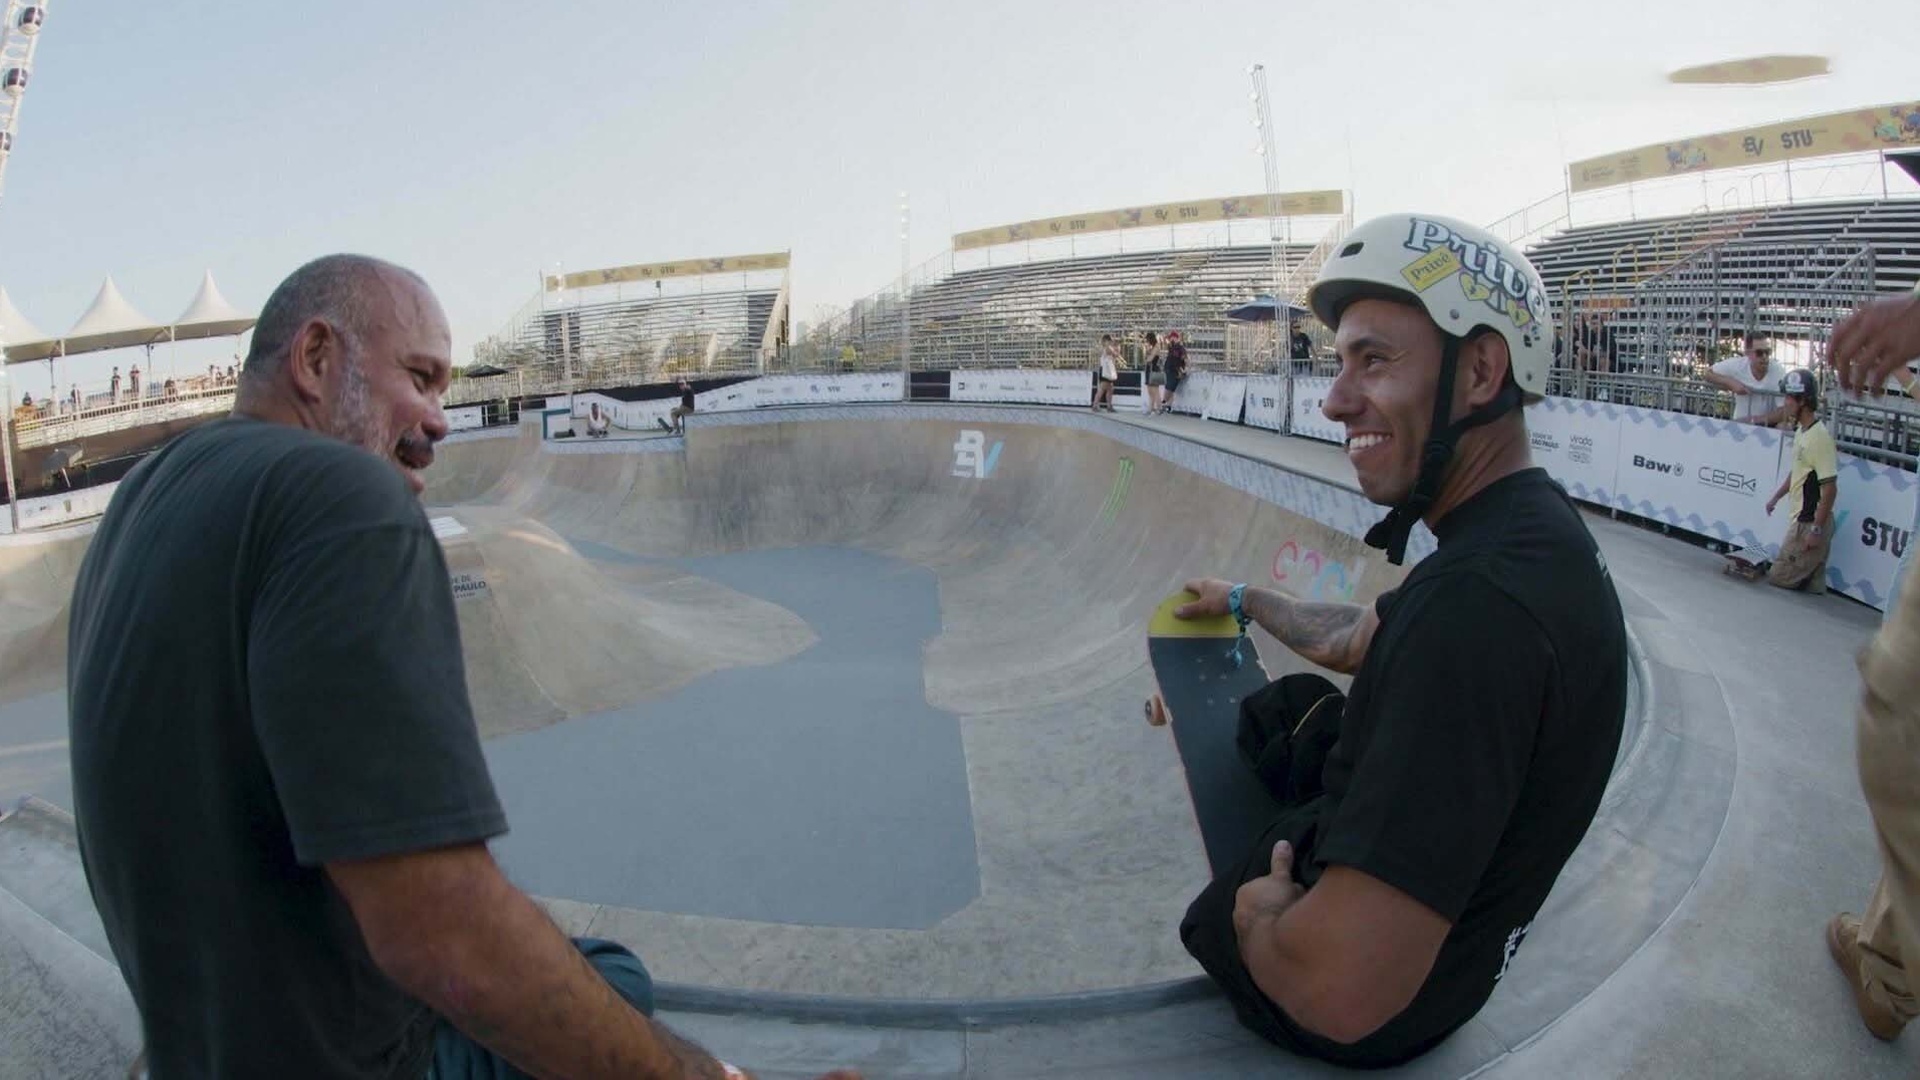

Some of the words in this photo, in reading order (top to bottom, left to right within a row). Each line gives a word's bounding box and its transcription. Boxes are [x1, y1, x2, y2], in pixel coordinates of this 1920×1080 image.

[1781, 129, 1813, 149] STU
[1633, 454, 1672, 474] Baw
[1698, 466, 1756, 492] CBSK
[1861, 516, 1909, 558] STU
[453, 580, 486, 593] PAULO
